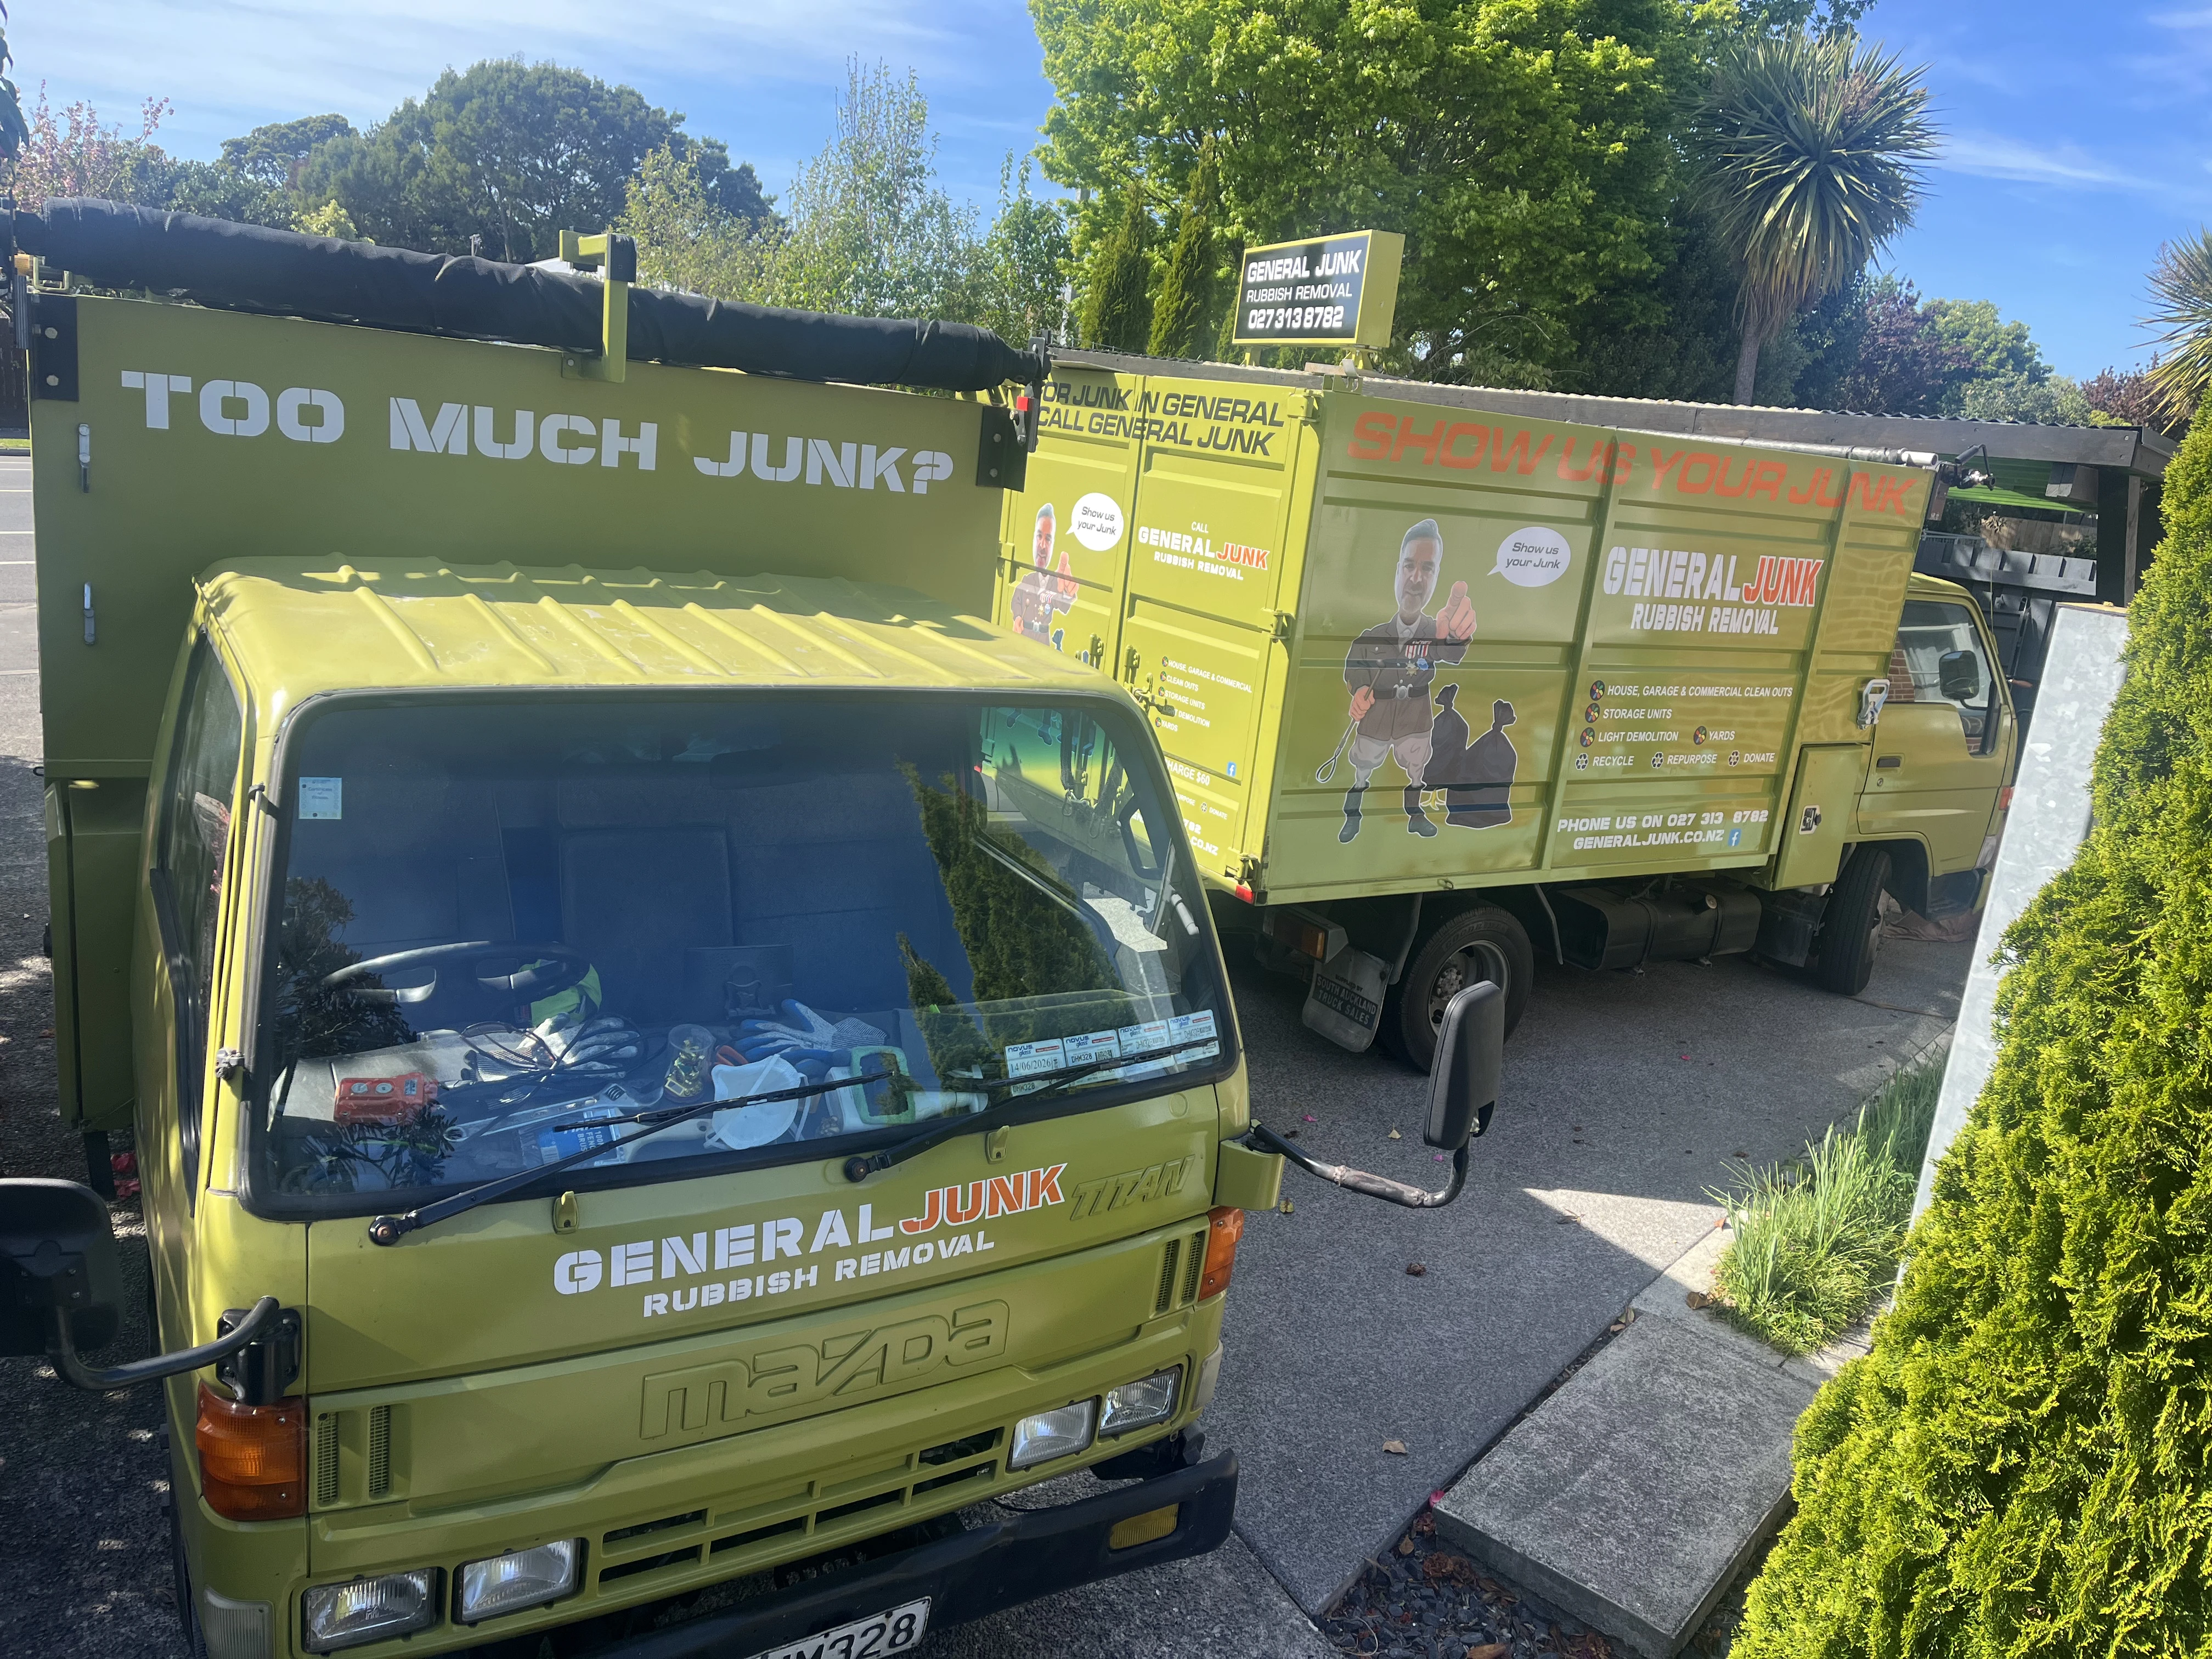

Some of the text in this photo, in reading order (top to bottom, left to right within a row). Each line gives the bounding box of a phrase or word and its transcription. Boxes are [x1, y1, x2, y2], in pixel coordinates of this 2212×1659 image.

[1247, 250, 1362, 282] GENERAL JUNK
[1246, 283, 1352, 302] RUBBISH REMOVAL
[1042, 382, 1284, 427] OR JUNK IN GENERAL
[121, 370, 953, 494] TOO MUCH JUNK?
[1038, 406, 1276, 456] CALL GENERAL JUNK
[1347, 411, 1917, 515] SHOW US YOUR JUNK
[1081, 506, 1104, 518] Show
[1077, 521, 1116, 535] your Junk
[1191, 521, 1209, 533] CALL
[1512, 542, 1544, 554] Show
[1154, 551, 1243, 580] RUBBISH REMOVAL
[1505, 558, 1561, 569] your Junk
[1630, 603, 1779, 634] RUBBISH REMOVAL
[1166, 675, 1199, 691] CLEAN OUTS
[1168, 659, 1187, 673] HOUSE,
[1188, 666, 1210, 679] GARAGE
[1216, 675, 1252, 693] COMMERCIAL
[1164, 690, 1205, 710] STORAGE UNITS
[1607, 685, 1793, 697] HOUSE, GARAGE & COMMERCIAL CLEAN OUTS
[1178, 712, 1210, 727] DEMOLITION
[1602, 708, 1672, 719] STORAGE UNITS
[1161, 720, 1178, 732] YARDS
[1598, 731, 1679, 743] LIGHT DEMOLITION
[1708, 731, 1735, 741] YARDS
[1593, 755, 1634, 766] RECYCLE
[1667, 754, 1717, 765] REPURPOSE
[1743, 752, 1775, 763] DONATE
[1165, 759, 1210, 786] HARGE $60
[1209, 806, 1228, 820] DONATE
[1557, 810, 1769, 833] PHONE US ON 027 313 8782
[1573, 830, 1725, 850] GENERALJUNK.CO.NZ
[1317, 976, 1376, 1015] SOUTH AUCKLAND
[1318, 990, 1369, 1024] TRUCK SALES
[1070, 1154, 1196, 1221] TITAN
[643, 1231, 996, 1317] RUBBISH REMOVAL
